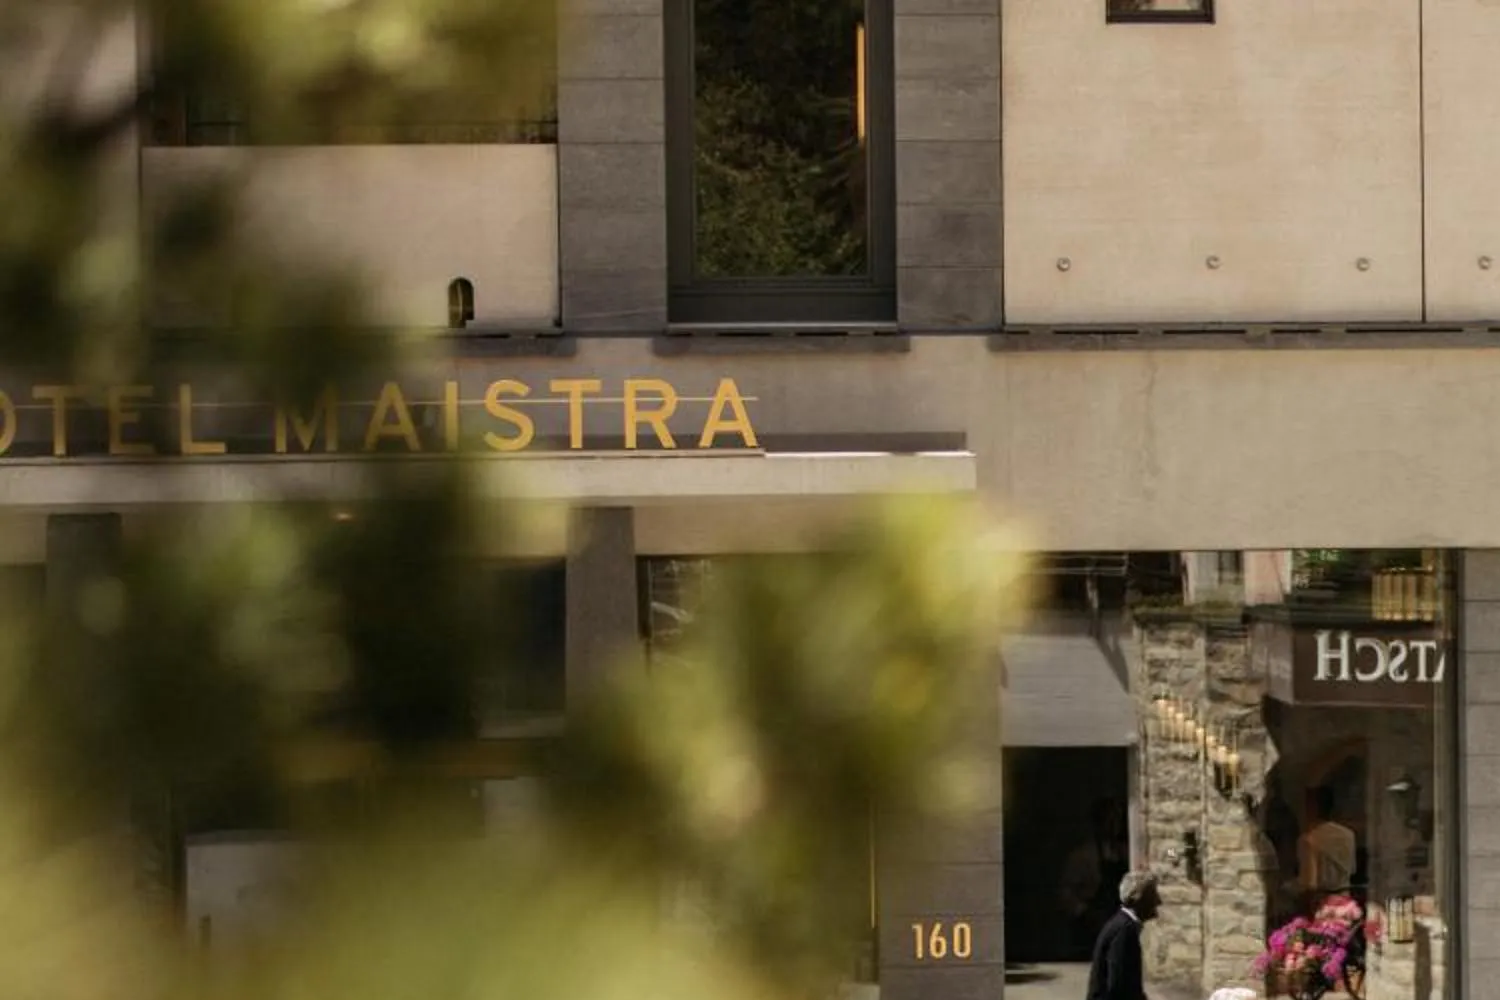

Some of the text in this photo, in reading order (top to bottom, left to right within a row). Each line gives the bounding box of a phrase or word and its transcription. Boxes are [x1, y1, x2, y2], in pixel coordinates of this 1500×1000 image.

[0, 378, 758, 456] TEL MAISTRA
[911, 922, 971, 959] 160
